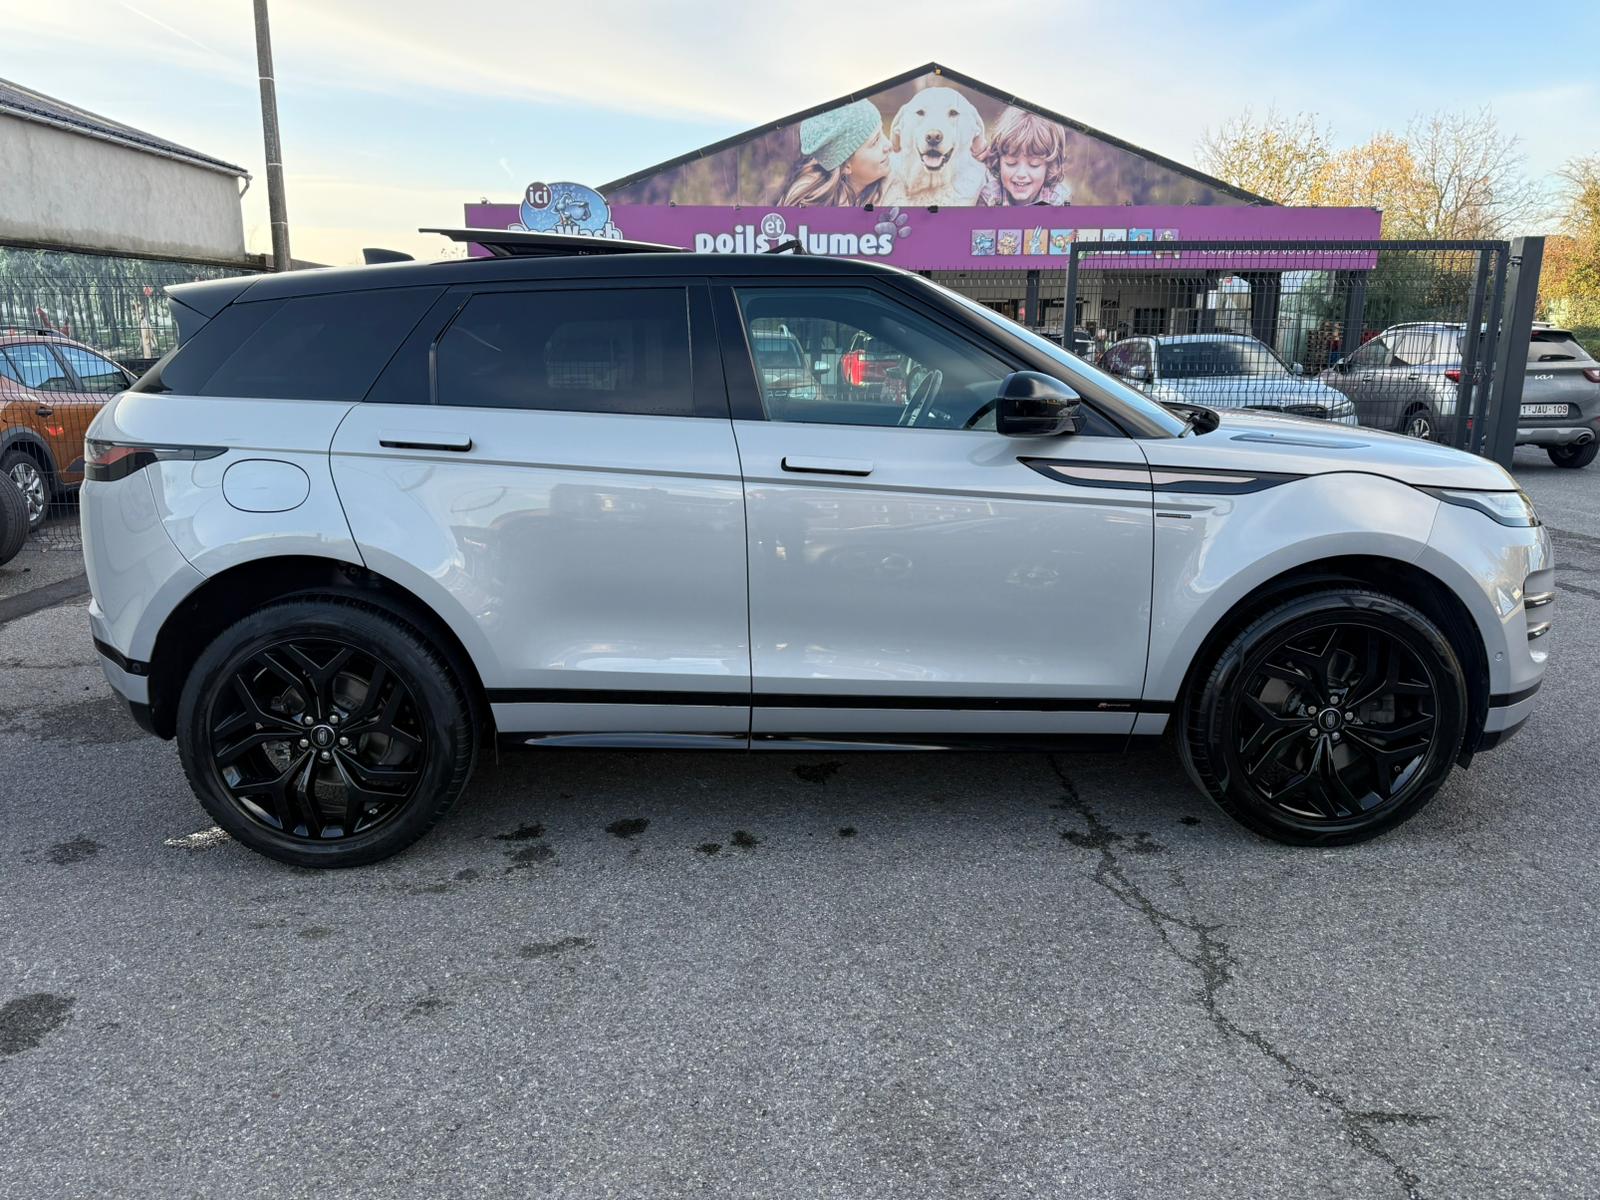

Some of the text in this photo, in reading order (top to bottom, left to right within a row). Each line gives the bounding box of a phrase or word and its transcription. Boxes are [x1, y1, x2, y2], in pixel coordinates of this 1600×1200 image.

[529, 186, 549, 204] ici
[694, 225, 770, 254] poils
[765, 219, 782, 234] et
